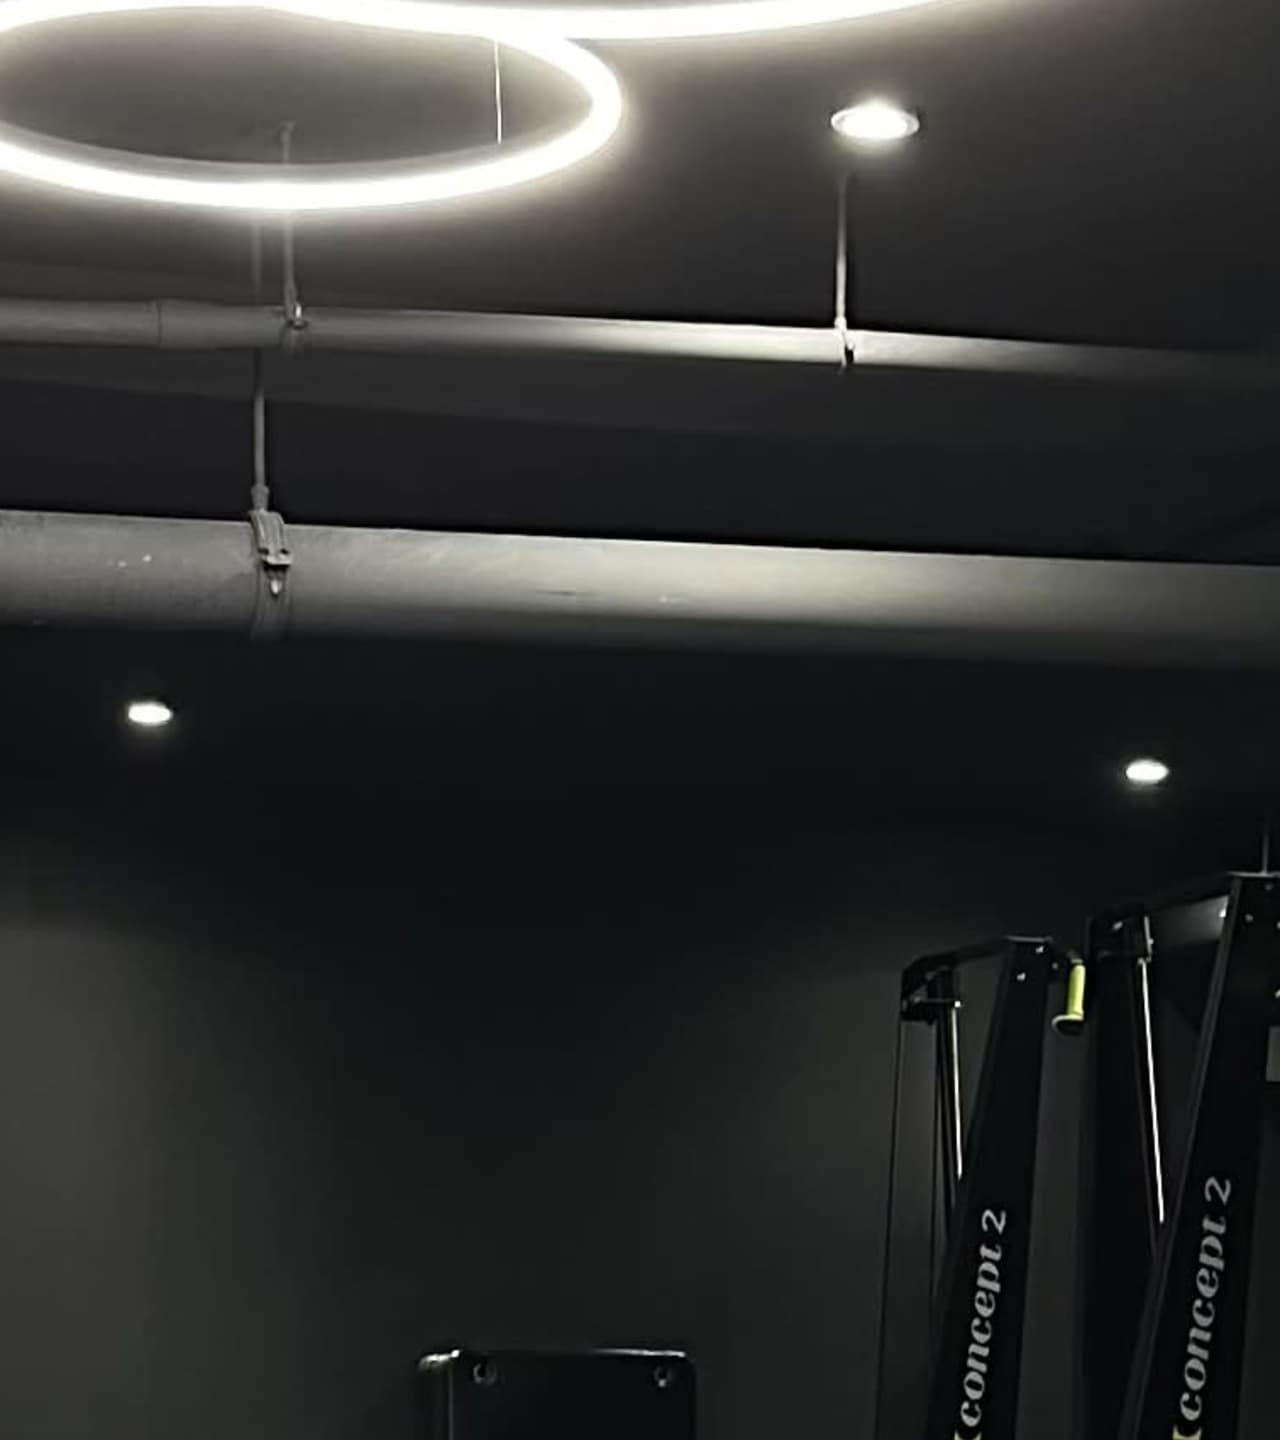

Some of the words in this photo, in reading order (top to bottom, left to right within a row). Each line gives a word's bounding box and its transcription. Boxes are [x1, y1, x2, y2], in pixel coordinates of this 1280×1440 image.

[980, 1207, 1007, 1236] 2
[1179, 1212, 1228, 1423] concept
[1204, 1175, 1232, 1206] 2
[959, 1242, 1003, 1428] concept
